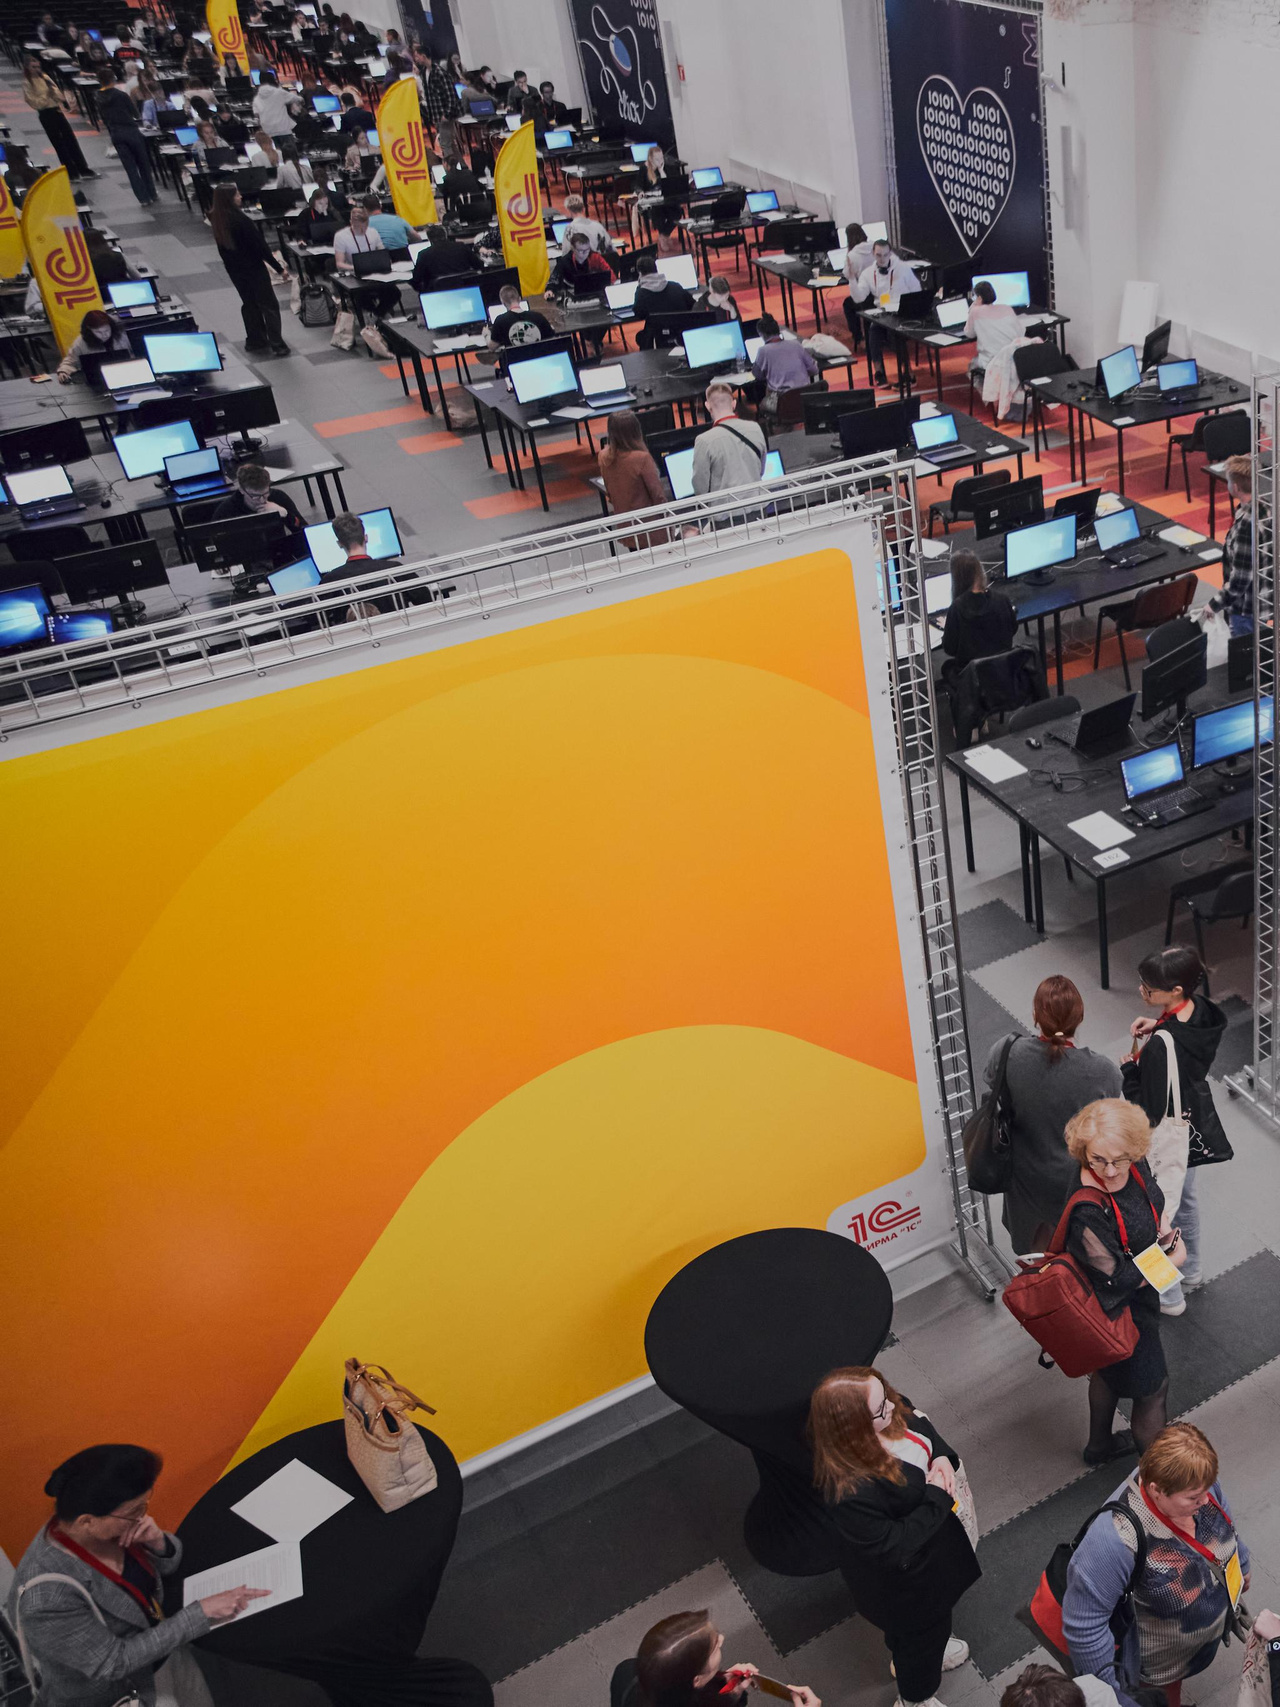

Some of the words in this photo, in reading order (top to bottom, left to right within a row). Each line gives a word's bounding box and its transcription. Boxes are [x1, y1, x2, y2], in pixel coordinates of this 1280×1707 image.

[928, 90, 954, 111] 10101
[924, 106, 960, 131] 1010101
[973, 103, 1000, 124] 10101
[968, 120, 1007, 144] 1010101
[943, 180, 996, 210] 010101010
[949, 199, 990, 226] 0101010
[963, 220, 978, 238] 101
[863, 1232, 898, 1251] ИРМА
